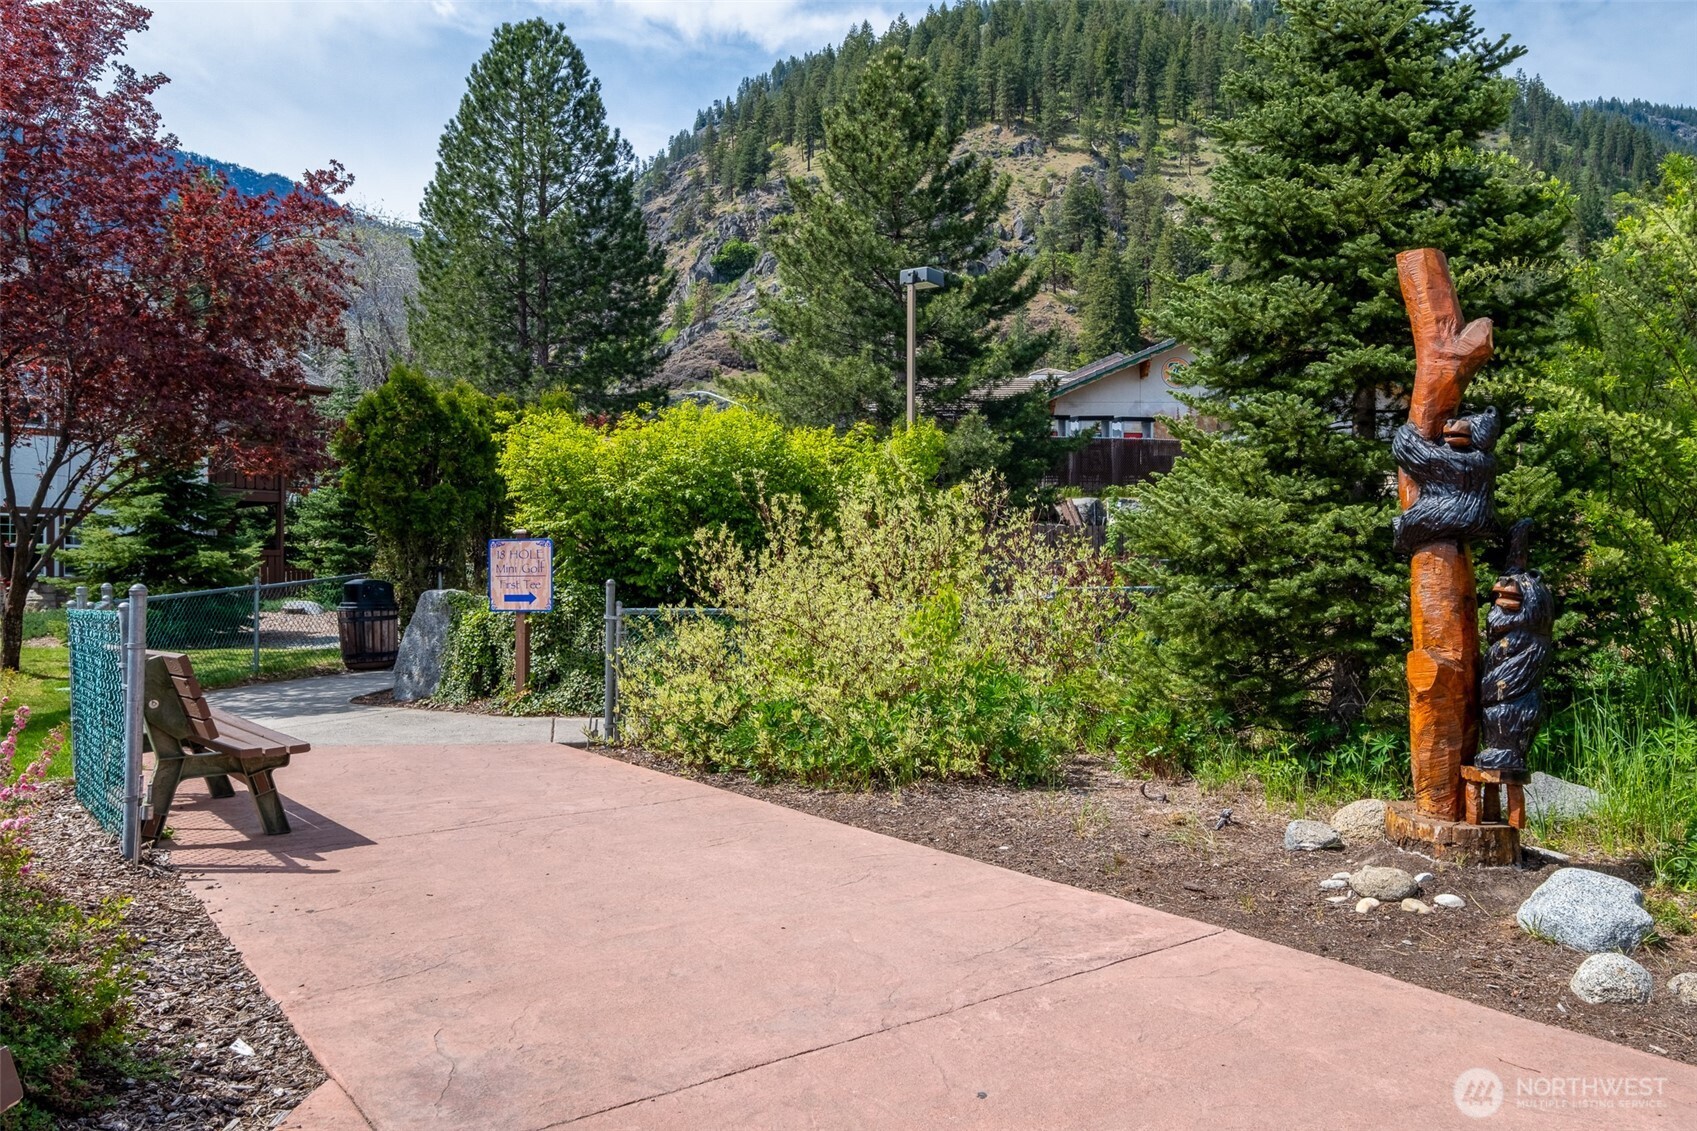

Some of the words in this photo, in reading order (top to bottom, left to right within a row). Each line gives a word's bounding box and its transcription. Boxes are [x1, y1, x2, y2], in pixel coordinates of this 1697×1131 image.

[496, 550, 506, 559] 18
[510, 549, 544, 559] HOLE
[495, 564, 517, 573] Mini
[521, 560, 545, 573] Golf
[499, 580, 519, 589] First
[523, 580, 541, 589] Tee
